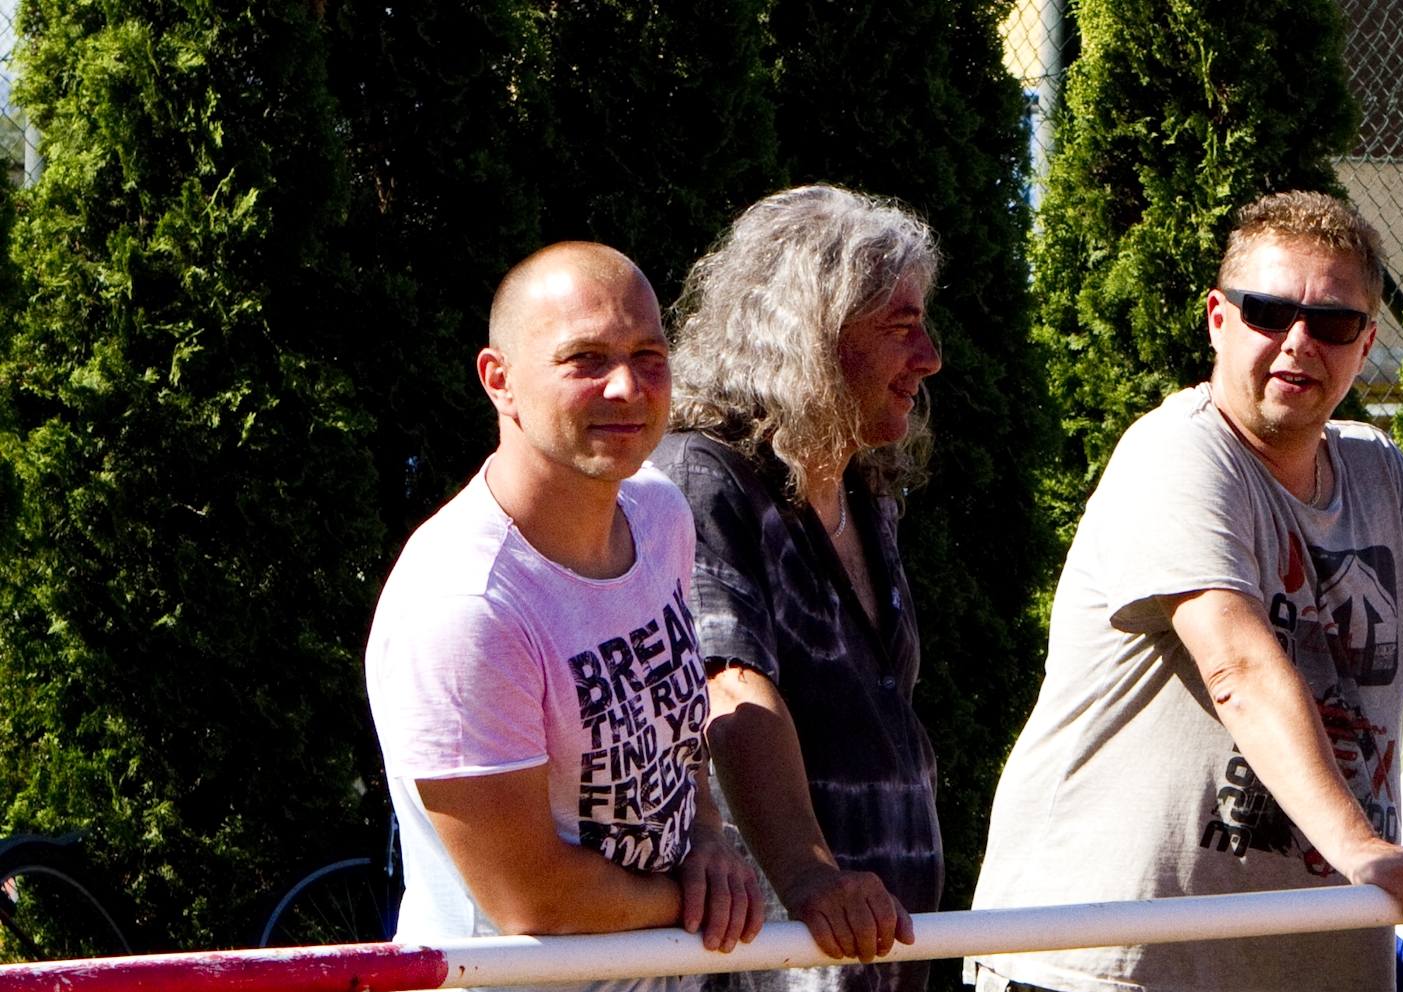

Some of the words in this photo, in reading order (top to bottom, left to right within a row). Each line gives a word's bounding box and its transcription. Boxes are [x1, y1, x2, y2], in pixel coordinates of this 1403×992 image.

[580, 725, 657, 783] FIND
[664, 693, 707, 744] YO
[581, 694, 648, 750] THE
[649, 659, 708, 718] RUL
